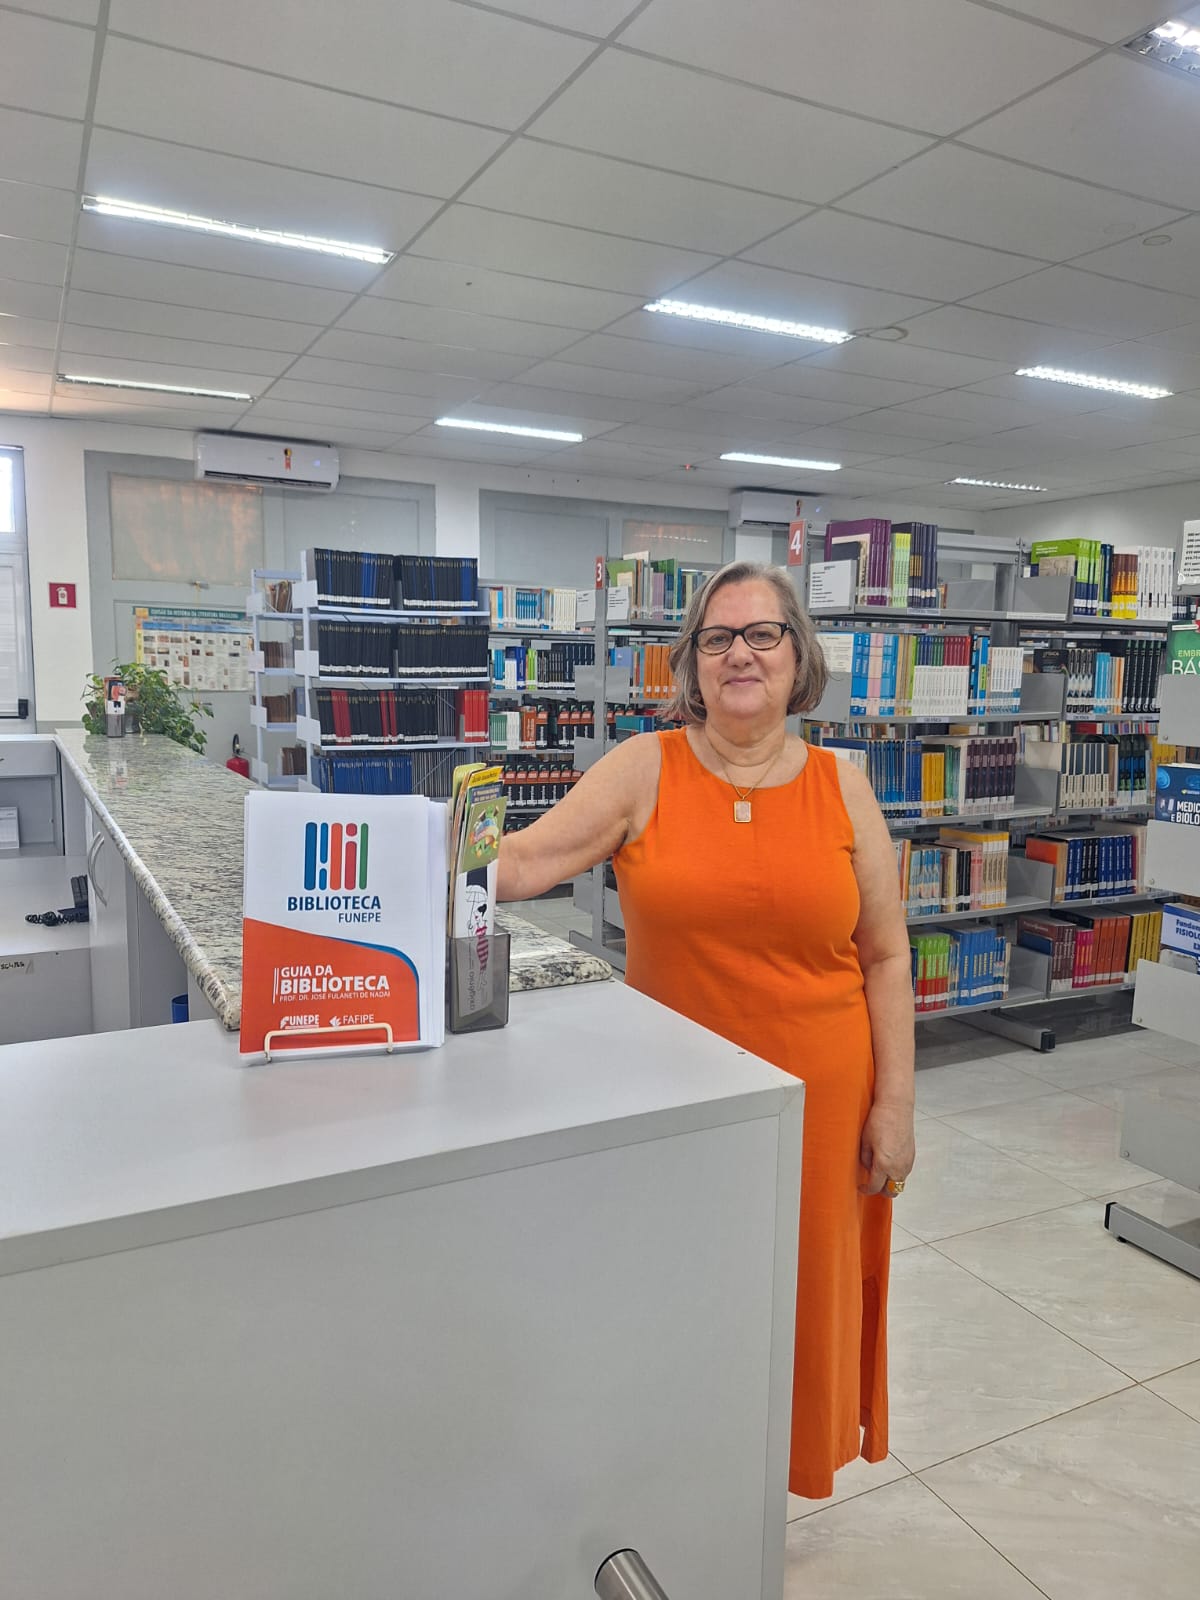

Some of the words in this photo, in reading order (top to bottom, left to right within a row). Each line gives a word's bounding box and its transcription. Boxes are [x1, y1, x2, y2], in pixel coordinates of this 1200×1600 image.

[790, 530, 802, 555] 4
[596, 563, 602, 582] 3
[287, 895, 382, 911] BIBLIOTECA
[338, 912, 381, 923] FUNEPE
[281, 966, 312, 977] GUIA
[315, 965, 333, 976] DA
[280, 976, 390, 995] BIBLIOTECA
[360, 991, 369, 999] DE
[280, 1014, 319, 1029] FUNEPE
[343, 1014, 375, 1024] FAFIPE
